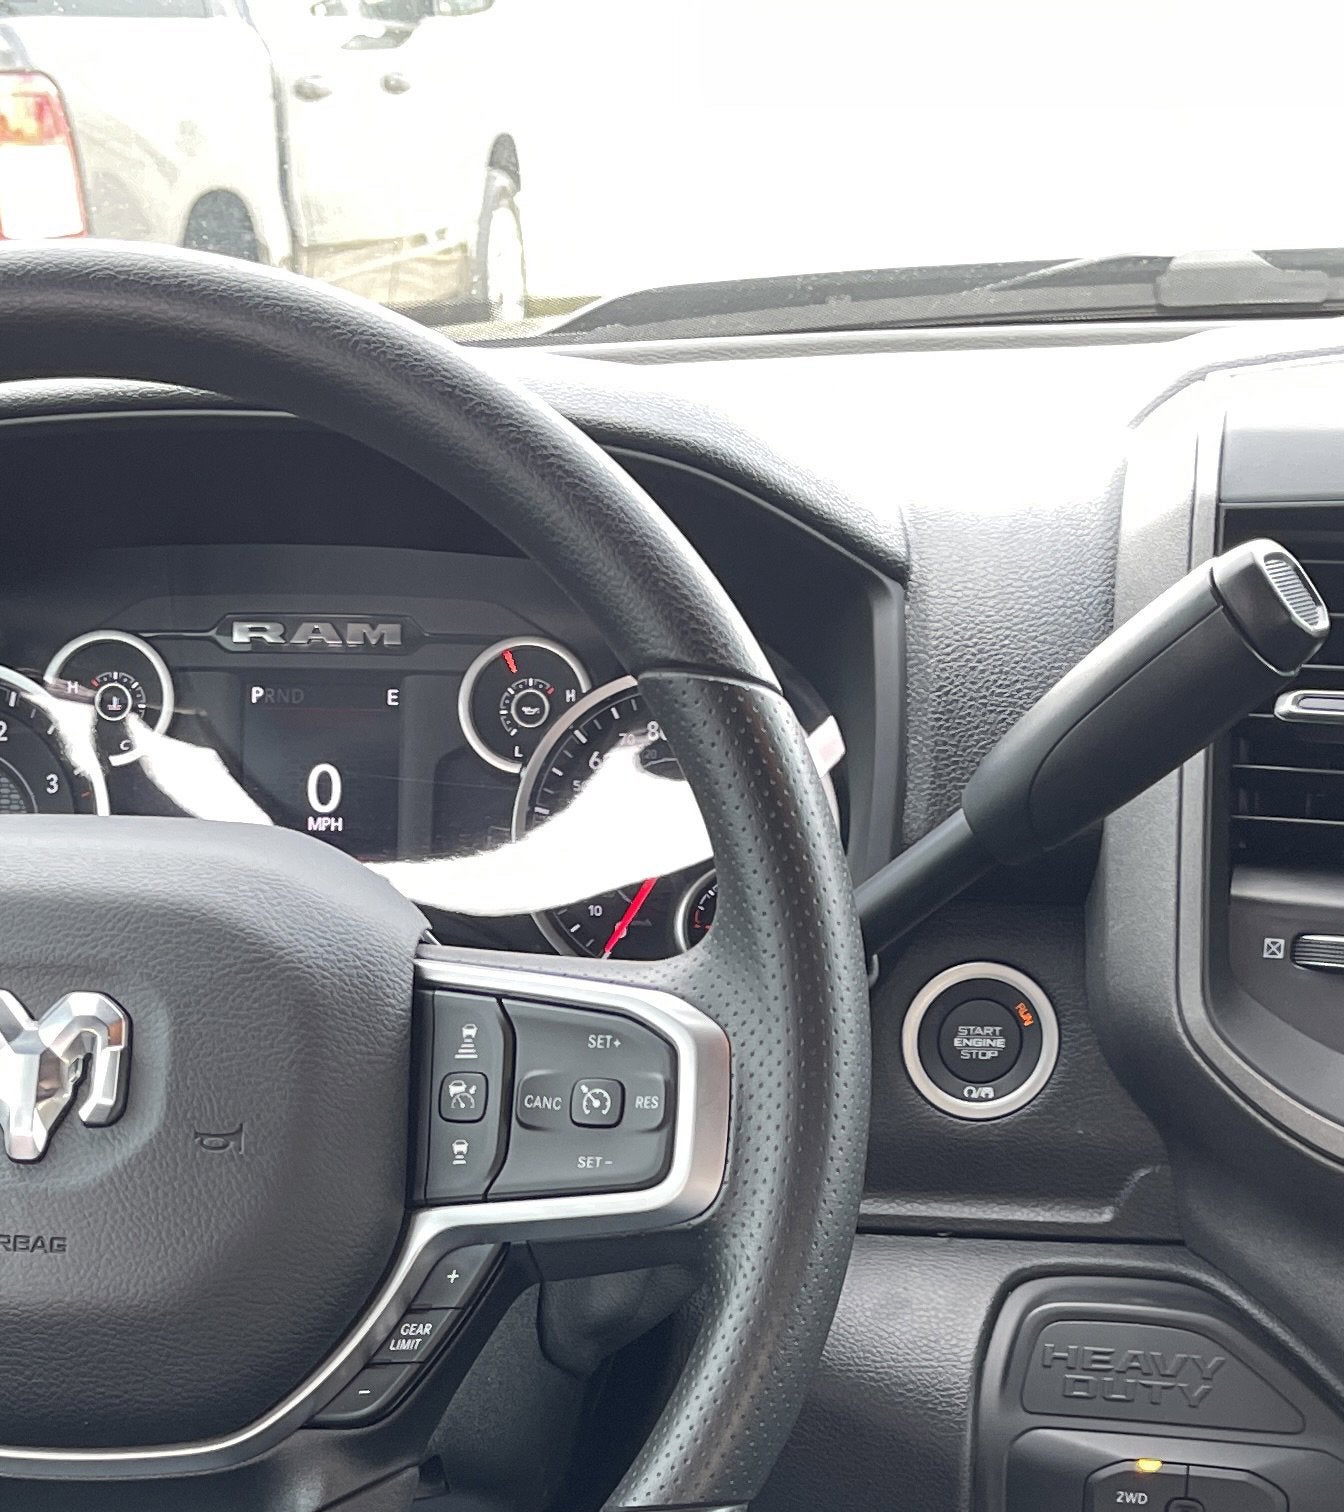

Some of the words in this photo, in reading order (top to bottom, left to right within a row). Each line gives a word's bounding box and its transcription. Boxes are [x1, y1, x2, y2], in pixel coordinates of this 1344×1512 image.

[232, 622, 402, 646] RAM
[386, 688, 400, 706] E
[565, 689, 576, 702] H
[514, 746, 523, 758] L
[46, 774, 59, 794] 3
[307, 762, 342, 813] 0
[307, 817, 343, 832] MPH
[588, 904, 603, 917] 10
[1015, 1002, 1034, 1028] RUN
[957, 1026, 1004, 1037] START
[953, 1037, 1006, 1049] ENGINE
[960, 1050, 999, 1060] STOP
[524, 1095, 562, 1111] CANC
[635, 1096, 659, 1109] RES
[400, 1323, 433, 1336] GEAR
[389, 1339, 423, 1351] LIMIT
[1042, 1343, 1226, 1381] HEAVY
[1062, 1374, 1214, 1408] DUTY
[1116, 1491, 1149, 1505] 2WD
